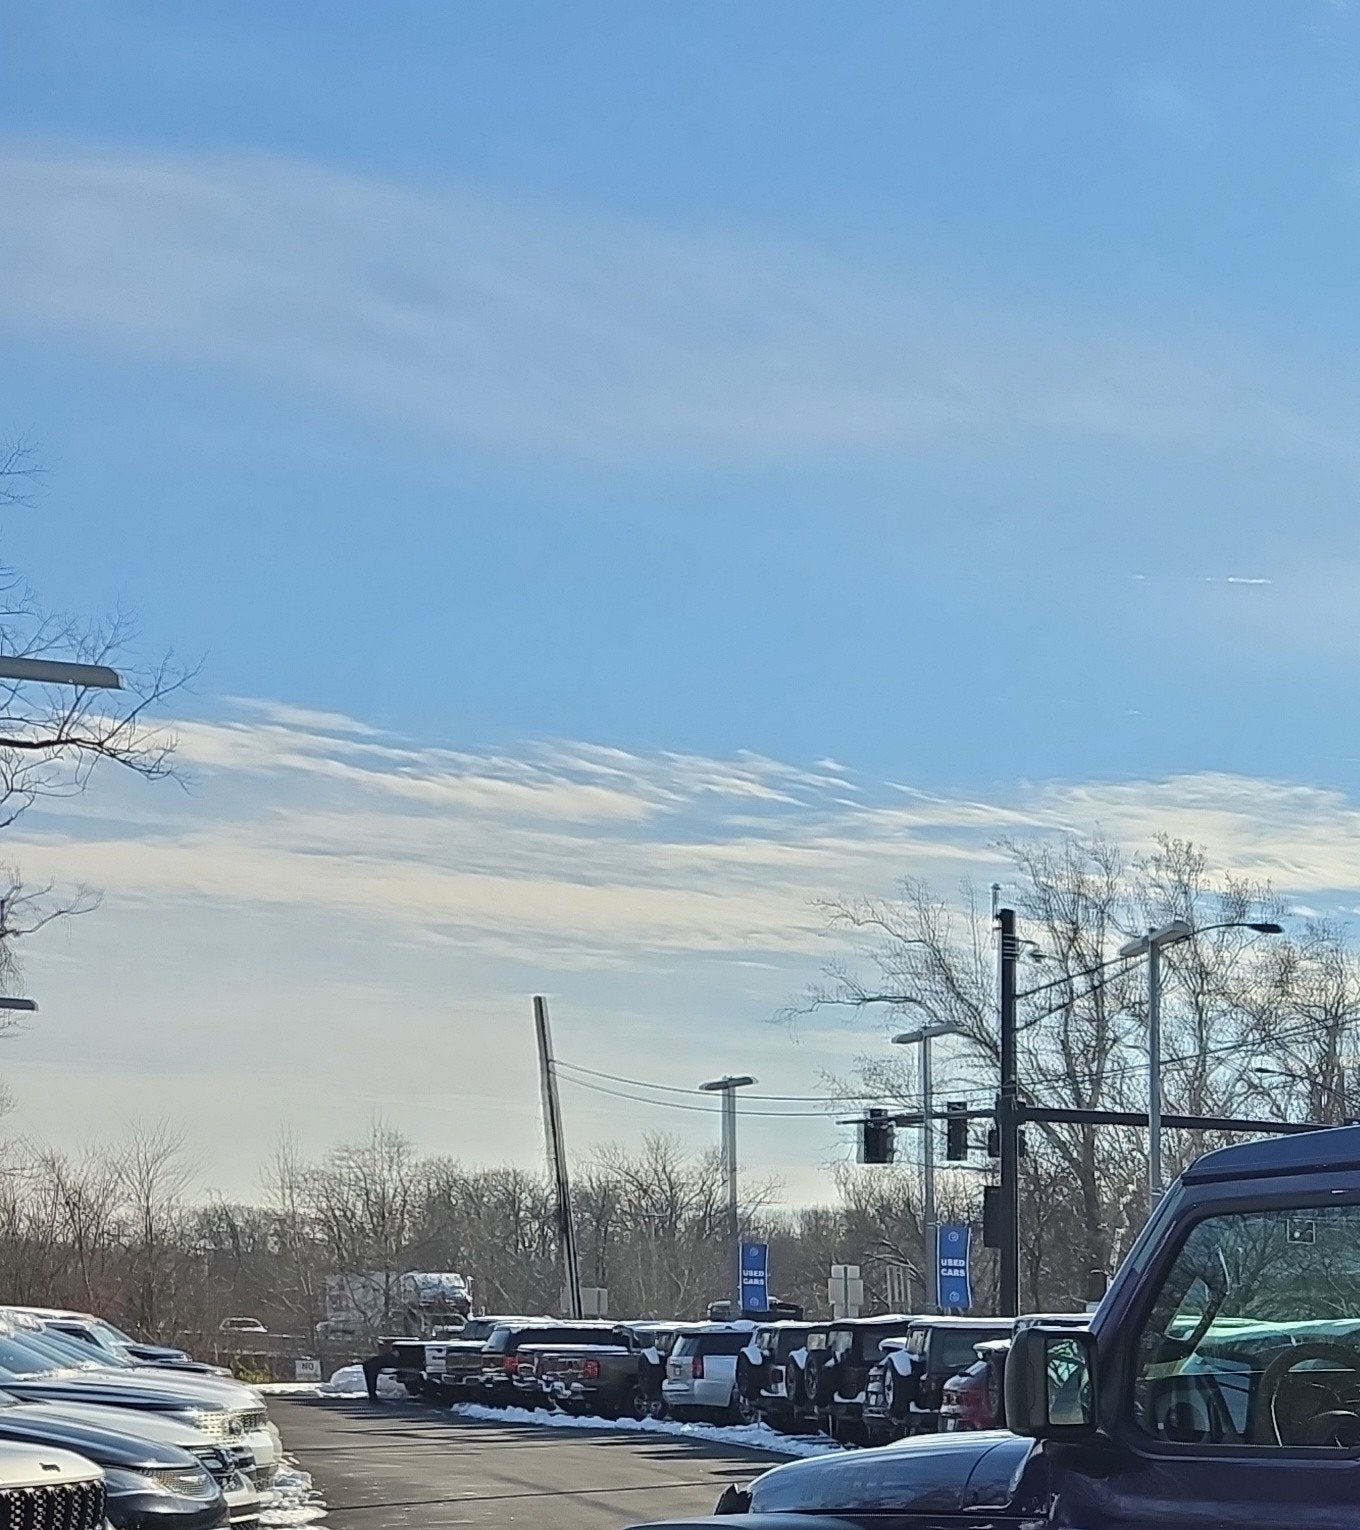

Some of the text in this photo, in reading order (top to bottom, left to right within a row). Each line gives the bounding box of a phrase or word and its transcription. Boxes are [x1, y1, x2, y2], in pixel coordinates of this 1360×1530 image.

[941, 1258, 966, 1267] USED
[743, 1269, 765, 1277] USED
[940, 1268, 966, 1277] CARS
[743, 1277, 765, 1286] CARS
